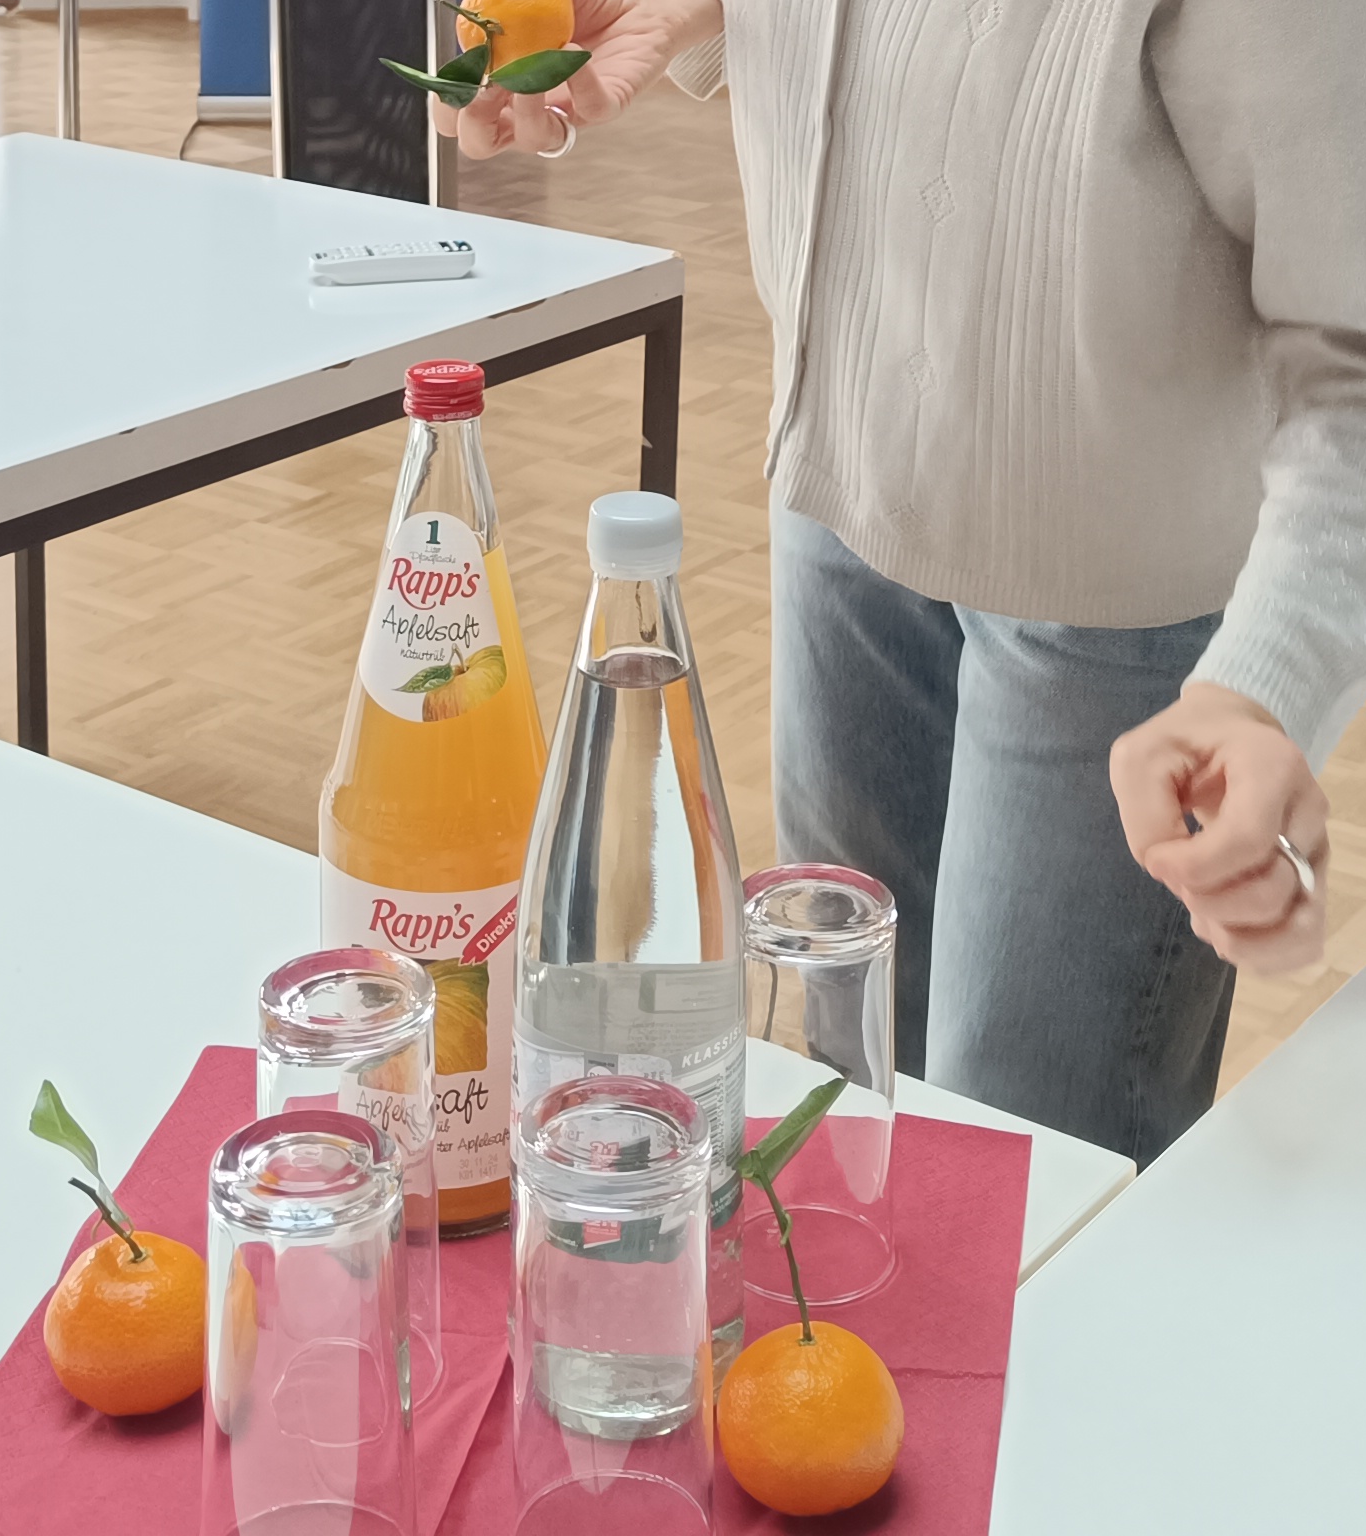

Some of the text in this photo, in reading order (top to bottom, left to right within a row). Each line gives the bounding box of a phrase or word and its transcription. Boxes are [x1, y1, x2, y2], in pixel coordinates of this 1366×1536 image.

[426, 520, 442, 545] 1
[387, 558, 481, 611] Rapp's
[381, 604, 480, 649] Apfelsaft
[368, 898, 475, 954] Rapp's
